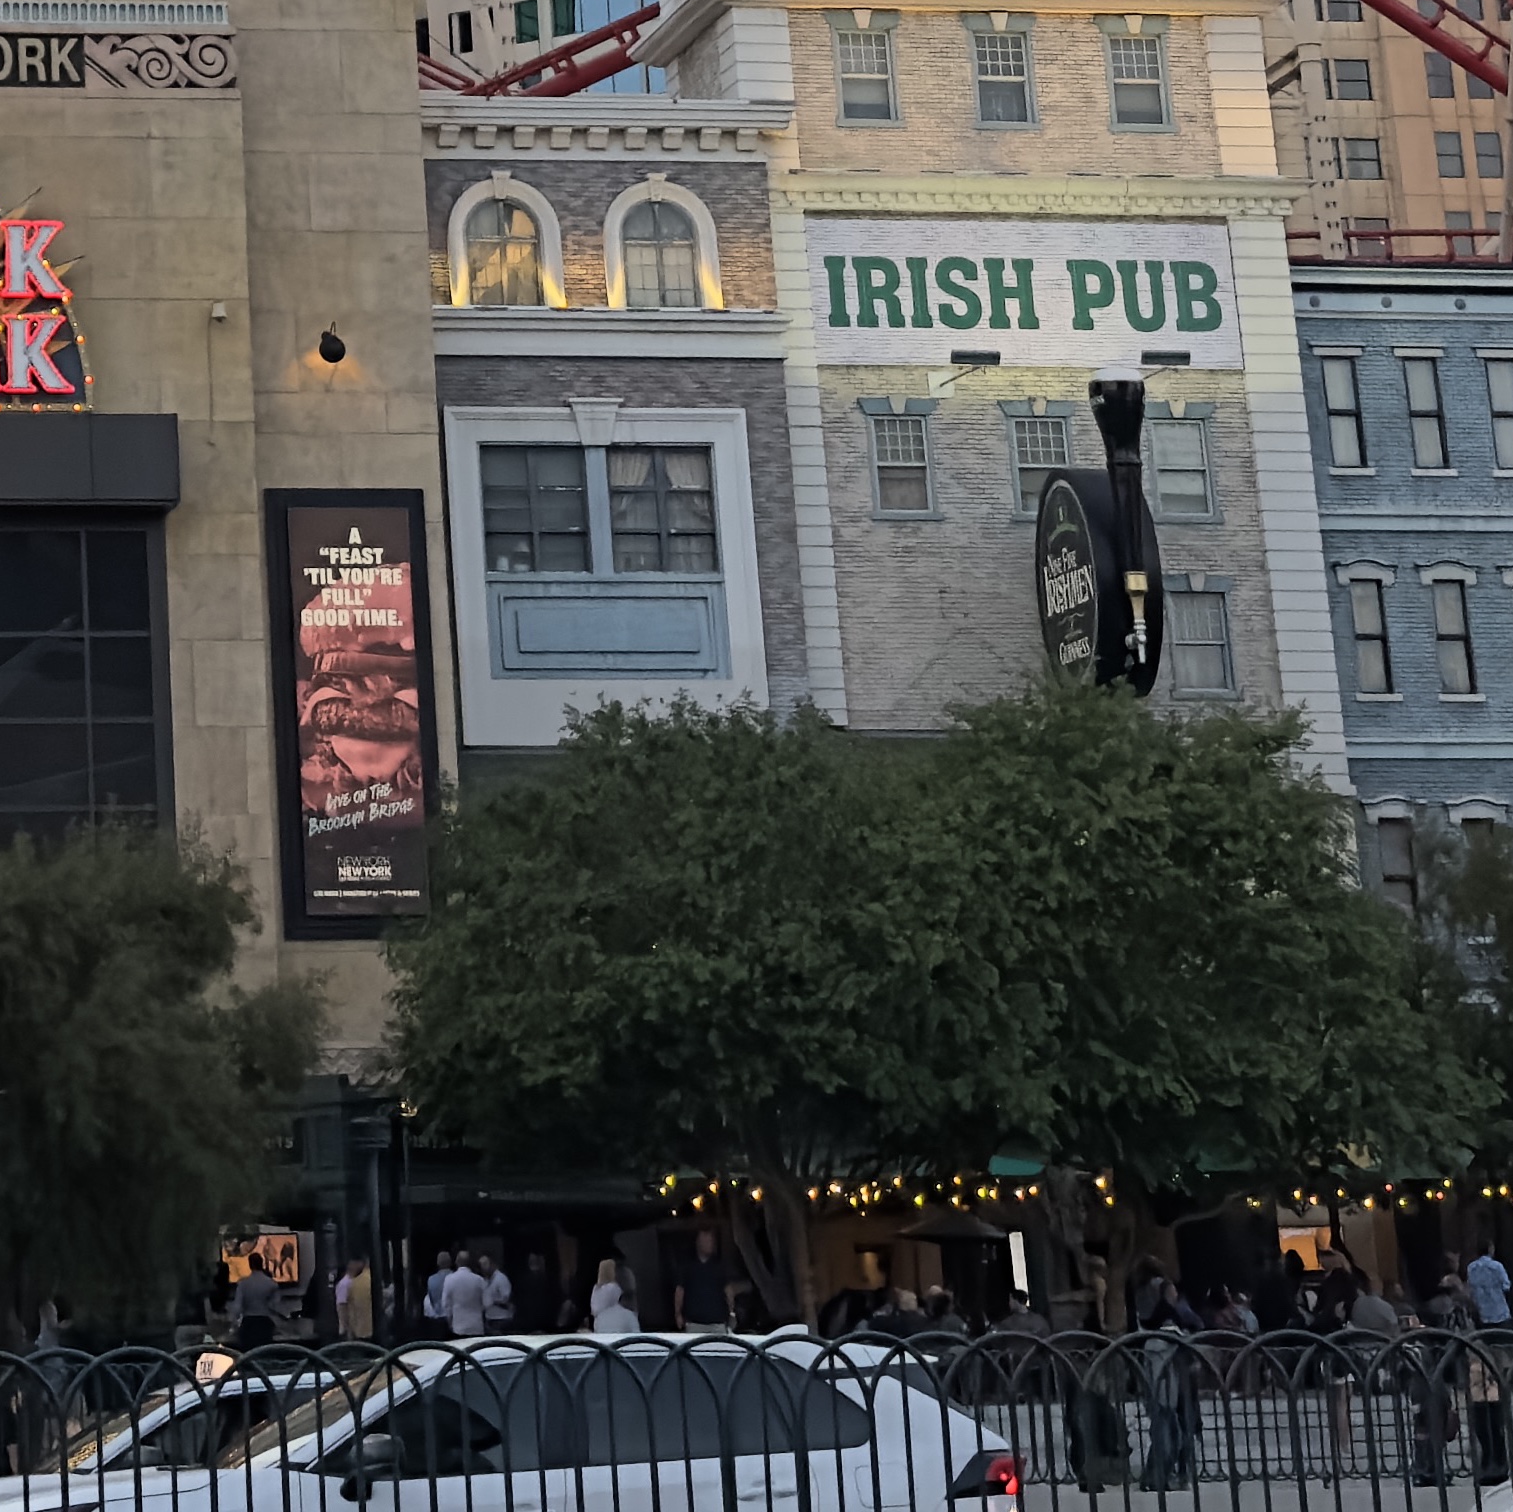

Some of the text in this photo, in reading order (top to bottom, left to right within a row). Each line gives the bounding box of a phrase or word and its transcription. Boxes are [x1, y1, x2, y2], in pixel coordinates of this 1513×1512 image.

[824, 255, 1223, 333] IRISH PUB
[348, 527, 362, 544] A
[319, 547, 384, 564] “FEAST
[321, 588, 372, 606] FULL”
[300, 608, 404, 626] GOOD TIME.
[363, 866, 392, 877] YORK
